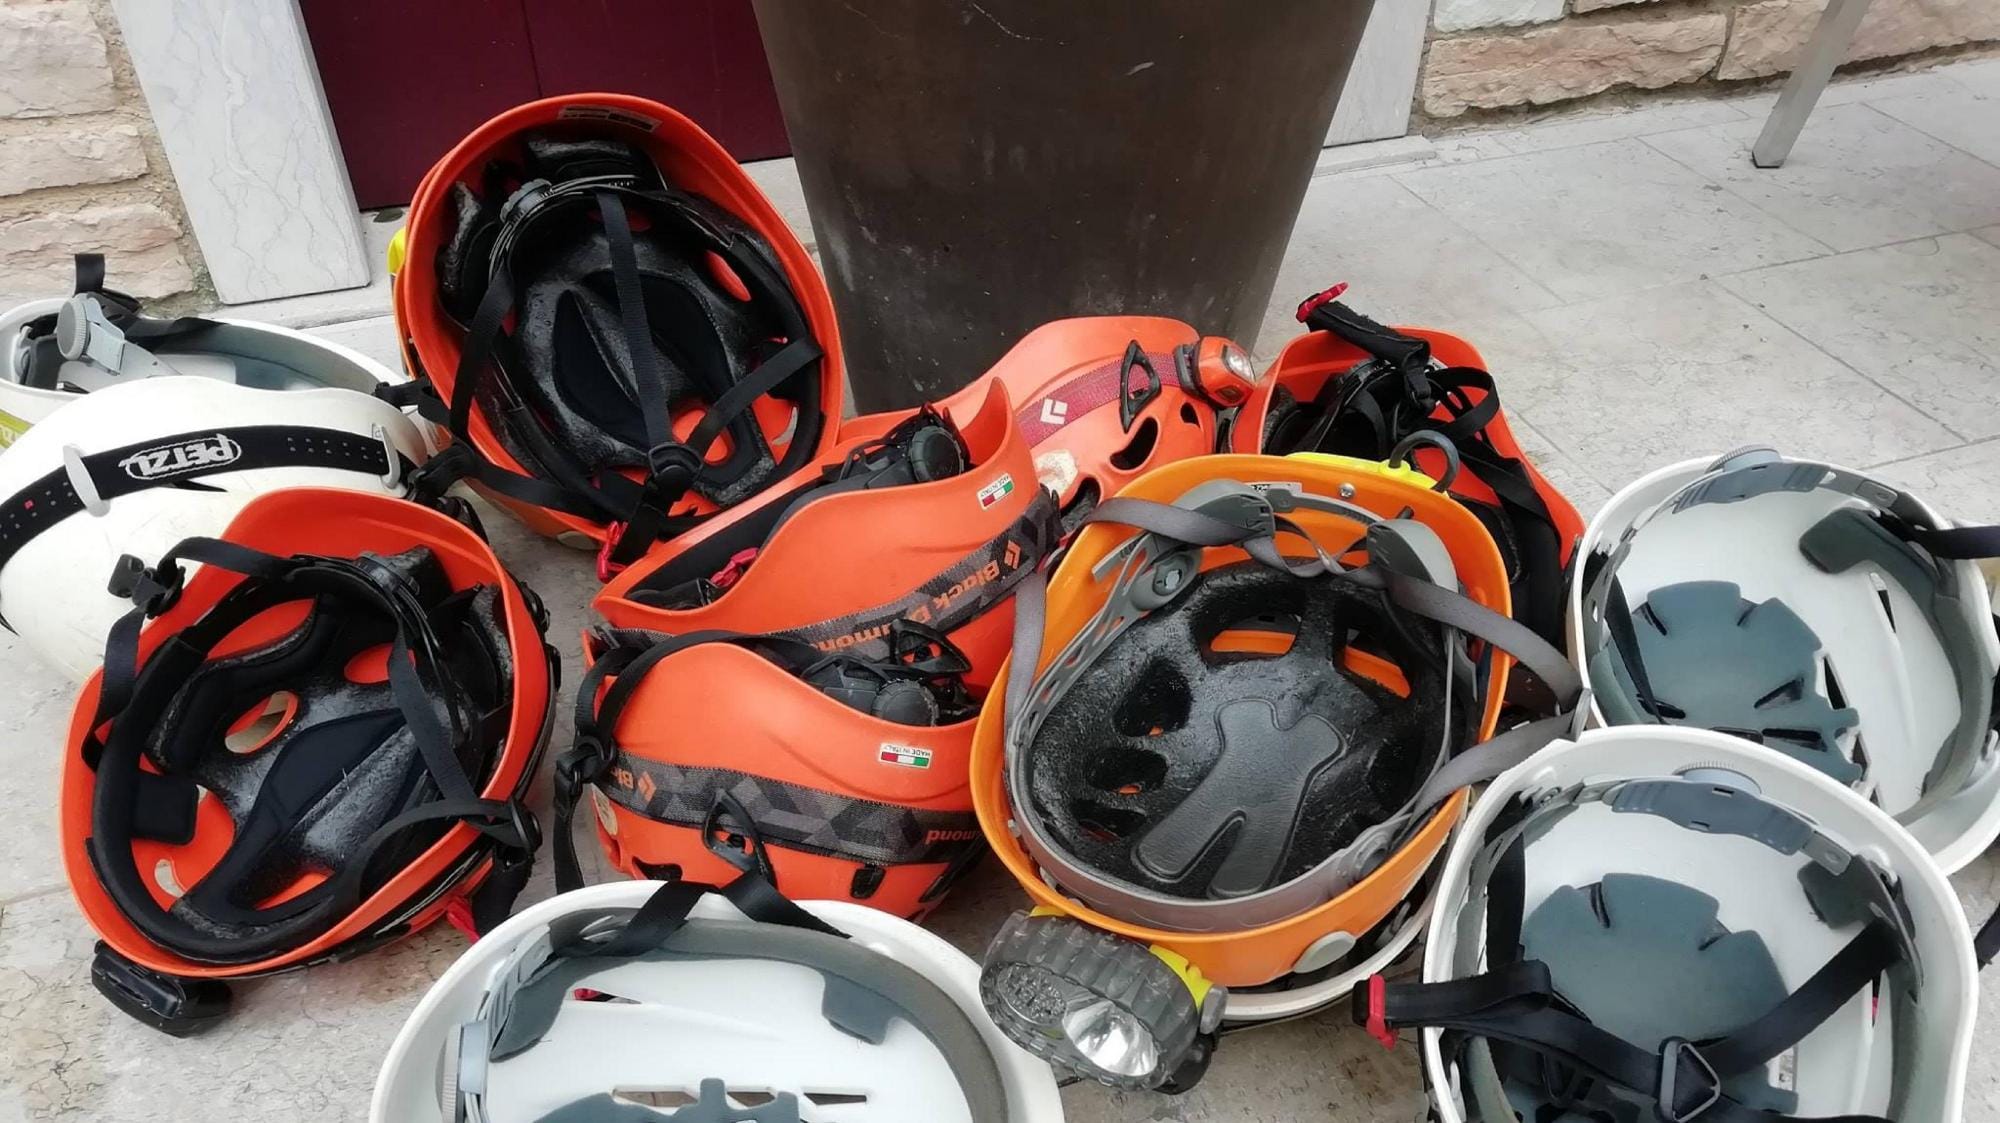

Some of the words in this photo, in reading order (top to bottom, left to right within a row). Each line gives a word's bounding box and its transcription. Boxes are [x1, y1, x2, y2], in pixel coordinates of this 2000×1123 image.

[118, 433, 234, 476] PETZL
[932, 559, 1001, 611] Black
[884, 745, 902, 753] ITALY
[911, 748, 931, 757] MADE
